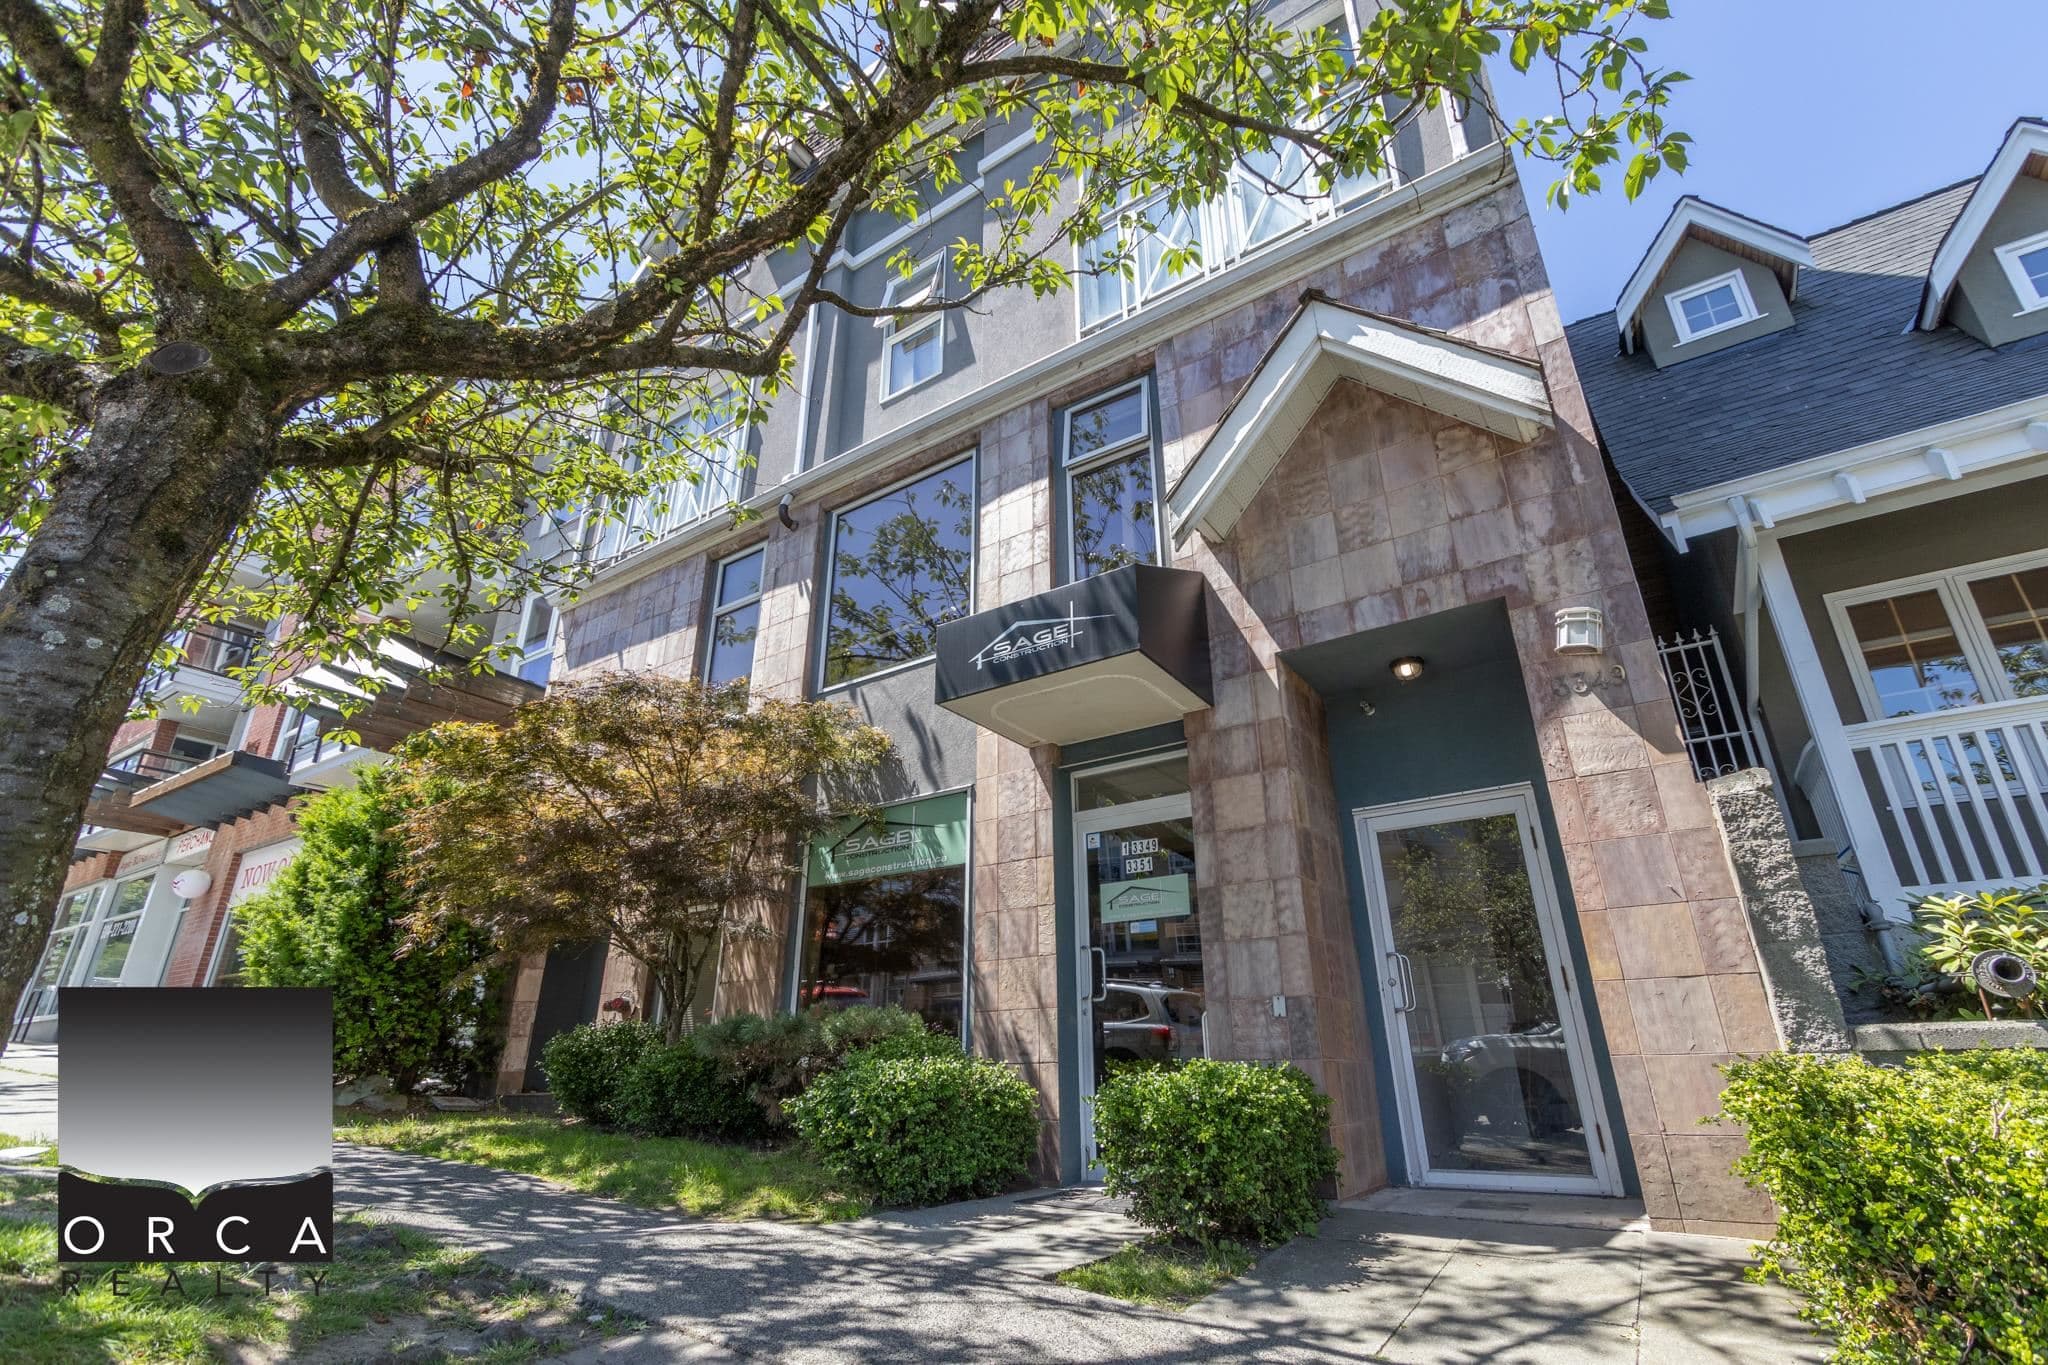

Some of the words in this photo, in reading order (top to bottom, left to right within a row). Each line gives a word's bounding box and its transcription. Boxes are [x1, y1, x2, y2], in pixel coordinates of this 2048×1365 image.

[993, 623, 1069, 658] SAGE
[992, 638, 1069, 664] CONSTRUCTION
[845, 829, 912, 852] SAGE
[1132, 839, 1157, 853] 3349
[1127, 858, 1152, 873] 3351
[1119, 892, 1159, 904] SAGE
